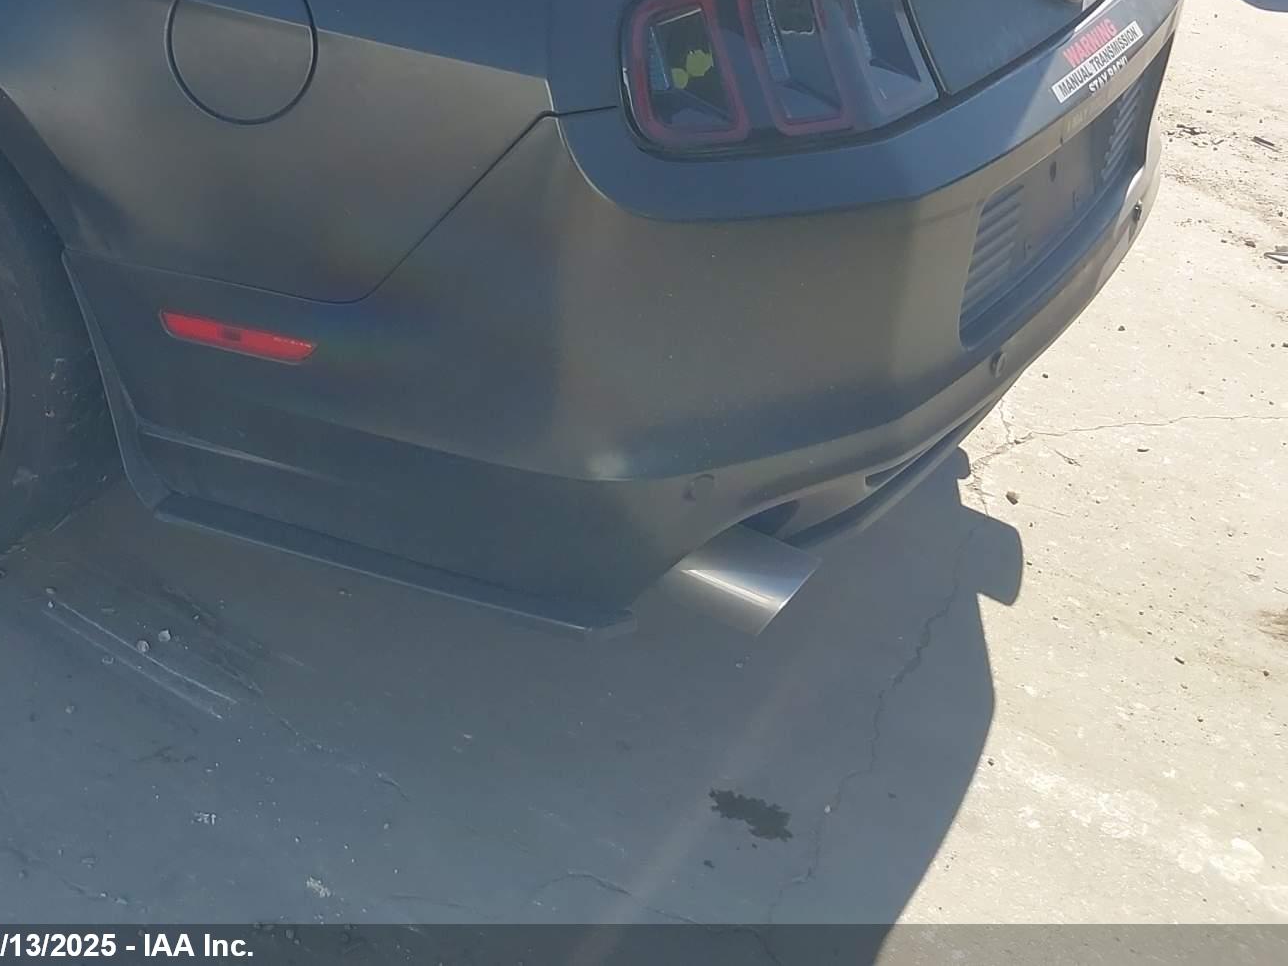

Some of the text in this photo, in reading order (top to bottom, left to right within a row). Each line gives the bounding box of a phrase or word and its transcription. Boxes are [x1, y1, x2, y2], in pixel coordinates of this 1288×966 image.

[1057, 26, 1139, 97] MANUAL TRANSMISSION
[1062, 18, 1118, 68] WARNING
